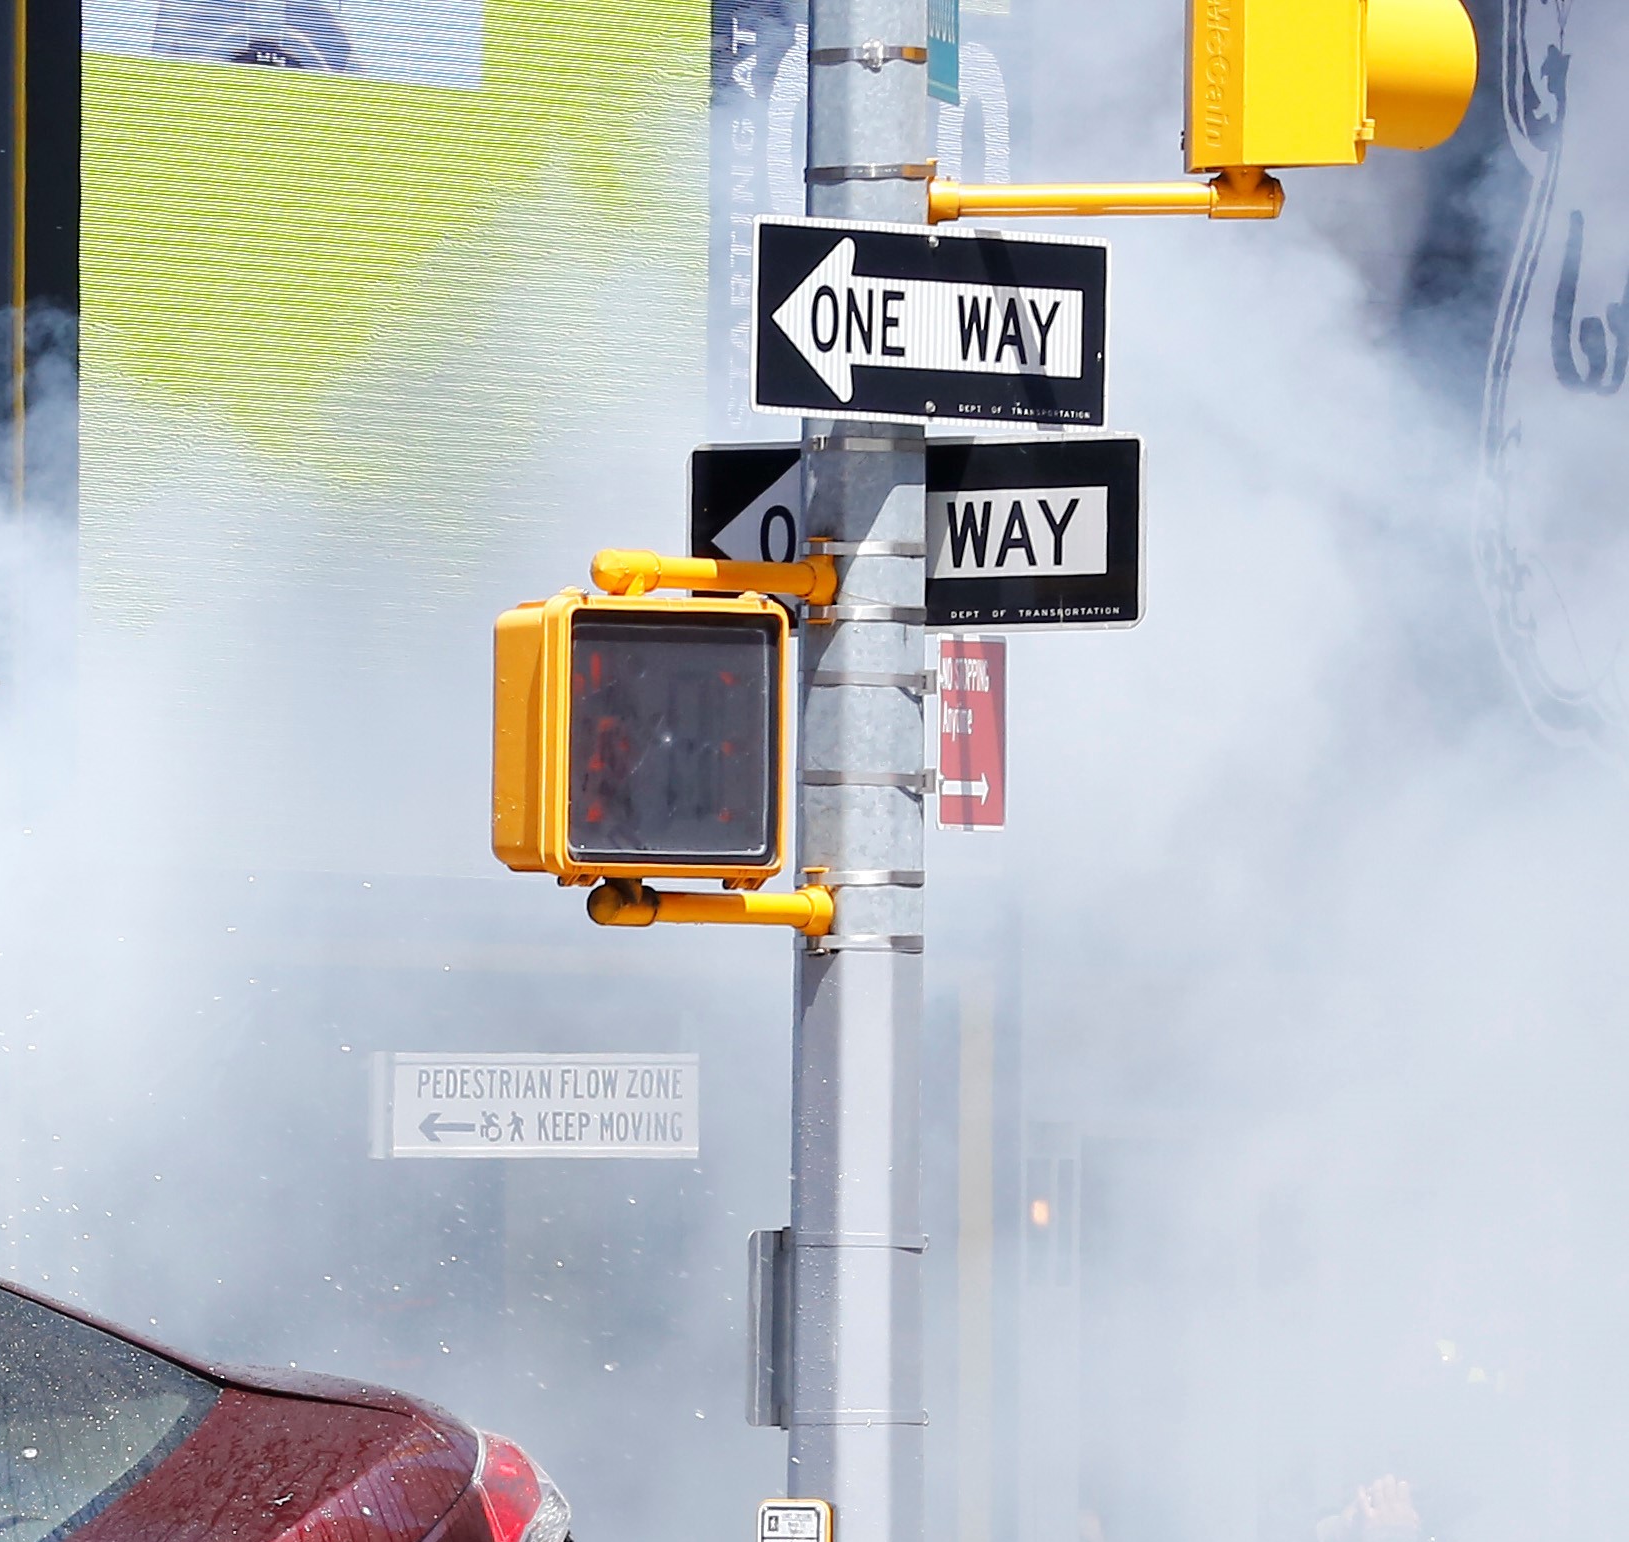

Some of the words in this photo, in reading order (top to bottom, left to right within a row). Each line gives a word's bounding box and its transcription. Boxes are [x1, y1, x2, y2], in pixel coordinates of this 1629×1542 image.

[810, 284, 906, 357] ONE
[957, 294, 1062, 367] WAY
[958, 403, 982, 413] DEPT
[991, 405, 1003, 415] OF
[946, 497, 1081, 569] WAY
[950, 609, 980, 619] DEPT
[991, 608, 1006, 618] OF
[1018, 606, 1120, 618] TRANSPORTATION
[417, 1068, 552, 1099] PEDESTRIAN
[560, 1068, 620, 1099] FLOW
[627, 1068, 684, 1100] ZONE
[537, 1111, 591, 1142] KEEP
[599, 1111, 684, 1142] MOVING
